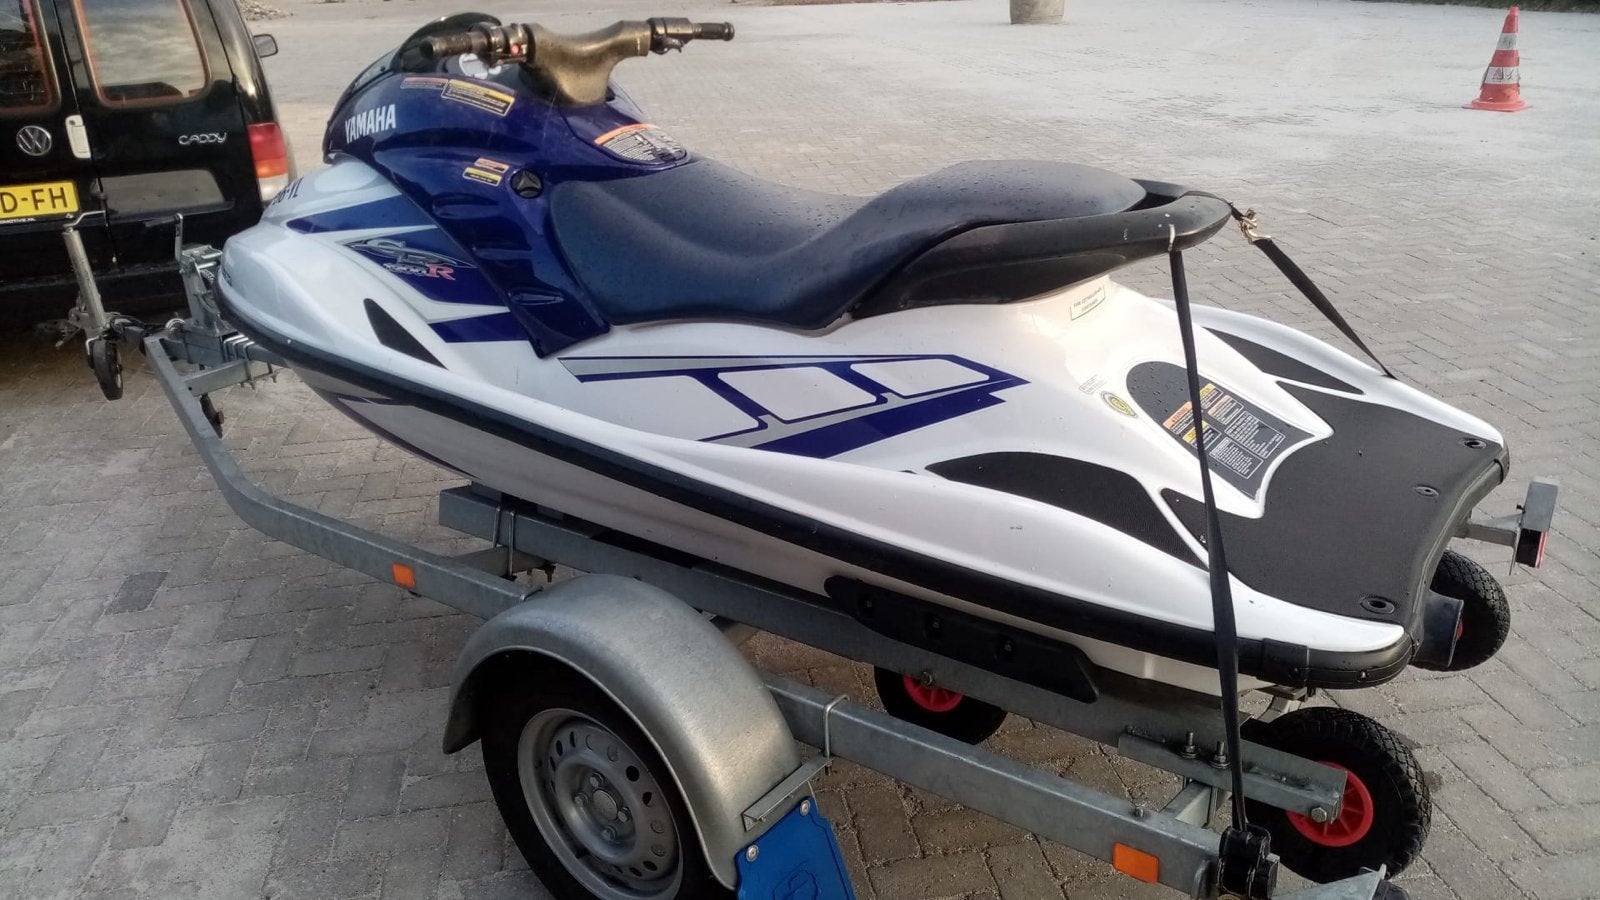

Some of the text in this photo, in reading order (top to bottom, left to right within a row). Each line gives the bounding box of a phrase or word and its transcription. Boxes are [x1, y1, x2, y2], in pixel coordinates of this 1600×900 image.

[344, 103, 396, 144] YAMAHA
[178, 132, 227, 145] CADDY
[0, 187, 68, 213] D-FH
